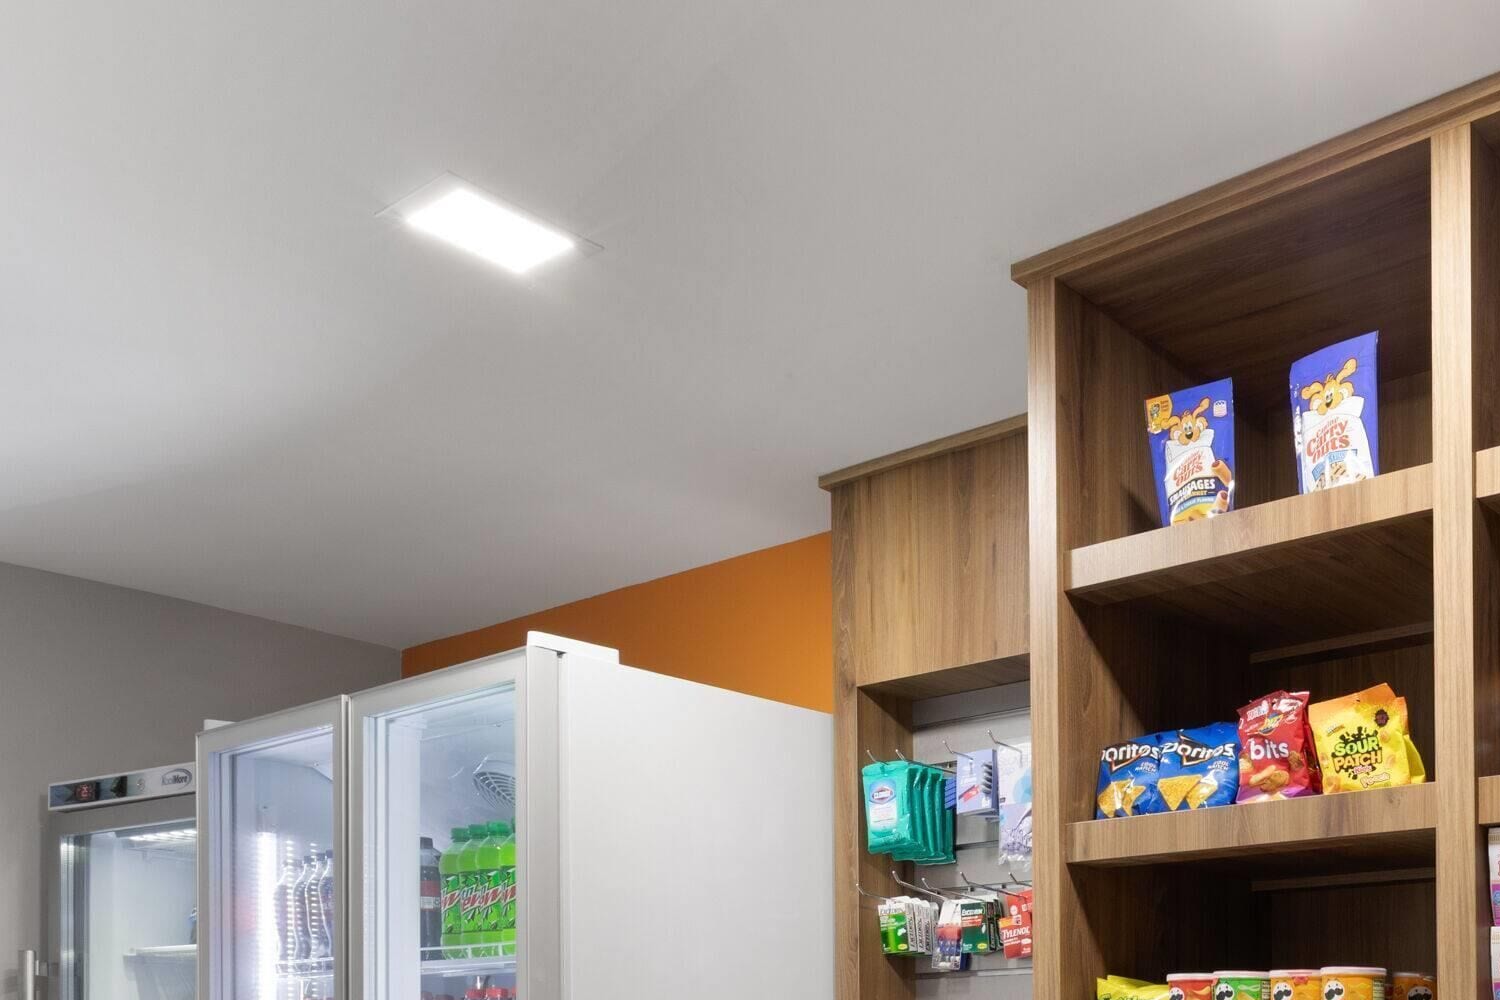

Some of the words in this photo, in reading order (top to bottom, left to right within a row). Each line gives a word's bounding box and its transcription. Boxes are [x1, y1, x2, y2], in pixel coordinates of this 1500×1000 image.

[1161, 742, 1235, 760] Doritos
[1250, 739, 1289, 760] bits
[1335, 737, 1379, 756] SOUR
[1333, 750, 1383, 773] PATCH
[1003, 927, 1030, 938] TYLENOL
